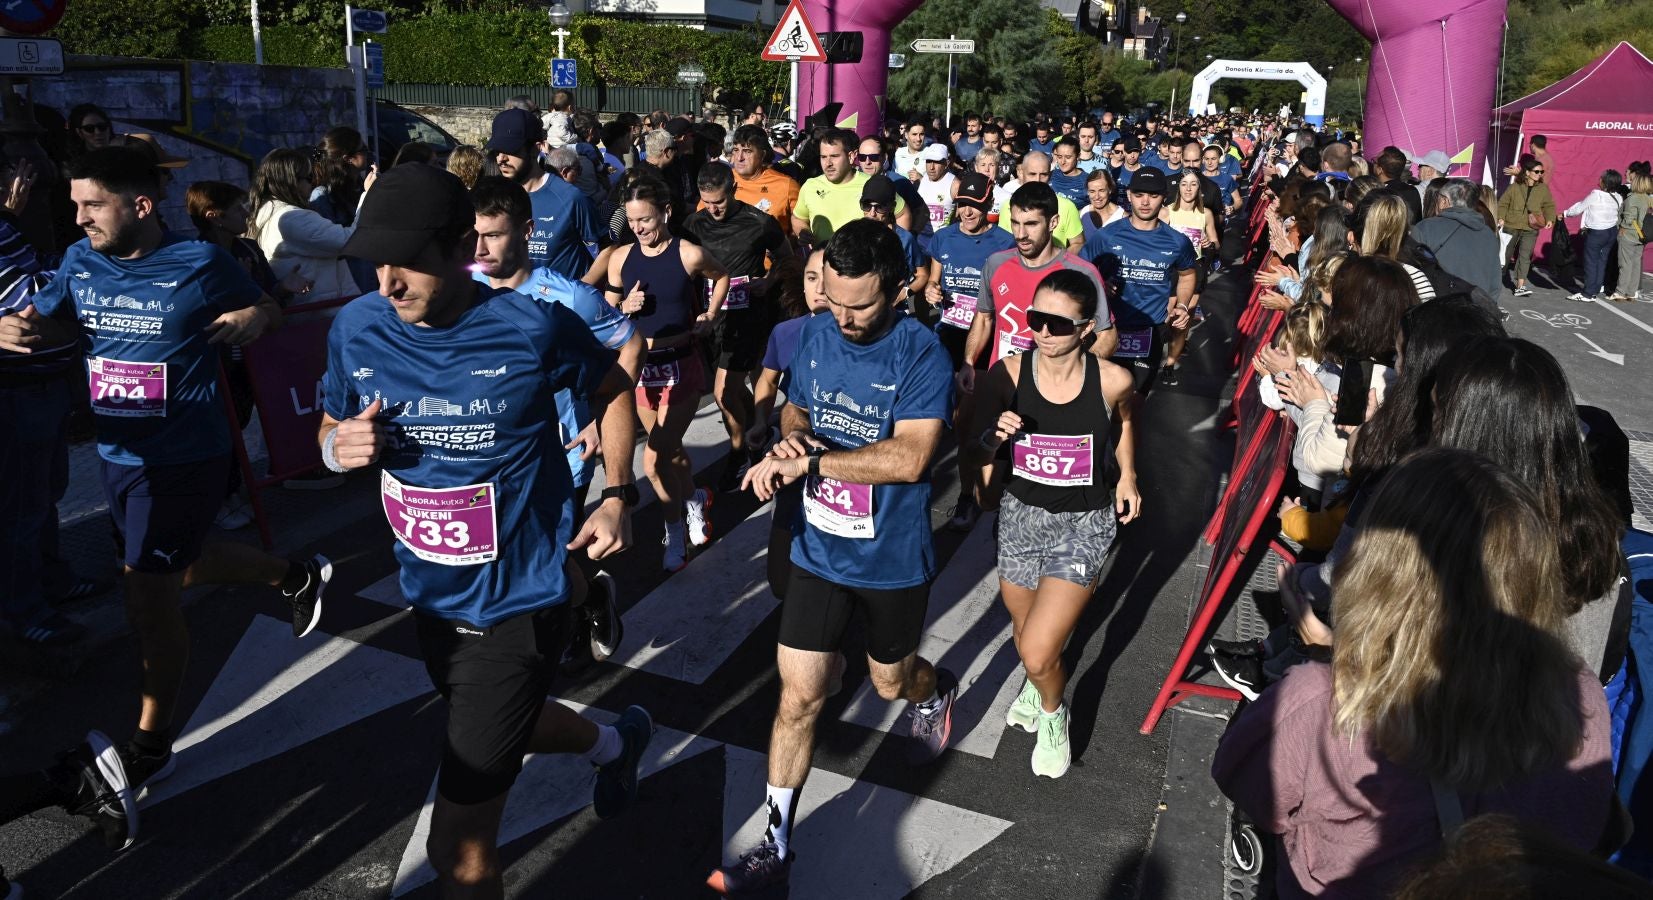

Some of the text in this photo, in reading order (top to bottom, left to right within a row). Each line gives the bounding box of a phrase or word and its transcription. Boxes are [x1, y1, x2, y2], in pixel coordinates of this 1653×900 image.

[1585, 121, 1634, 130] LABORAL
[946, 307, 975, 322] 288
[100, 317, 163, 330] KROSSA
[101, 374, 140, 385] LARSSON
[96, 381, 147, 404] 704
[408, 422, 496, 432] HONDARTZETAKO
[820, 414, 880, 438] KROSSA
[405, 430, 496, 444] KROSSA
[451, 440, 495, 450] PLAYAS
[1037, 448, 1062, 456] LEIRE
[1025, 454, 1076, 475] 867
[404, 494, 440, 506] LABORAL
[406, 507, 452, 520] EUKENI
[399, 510, 470, 549] 733
